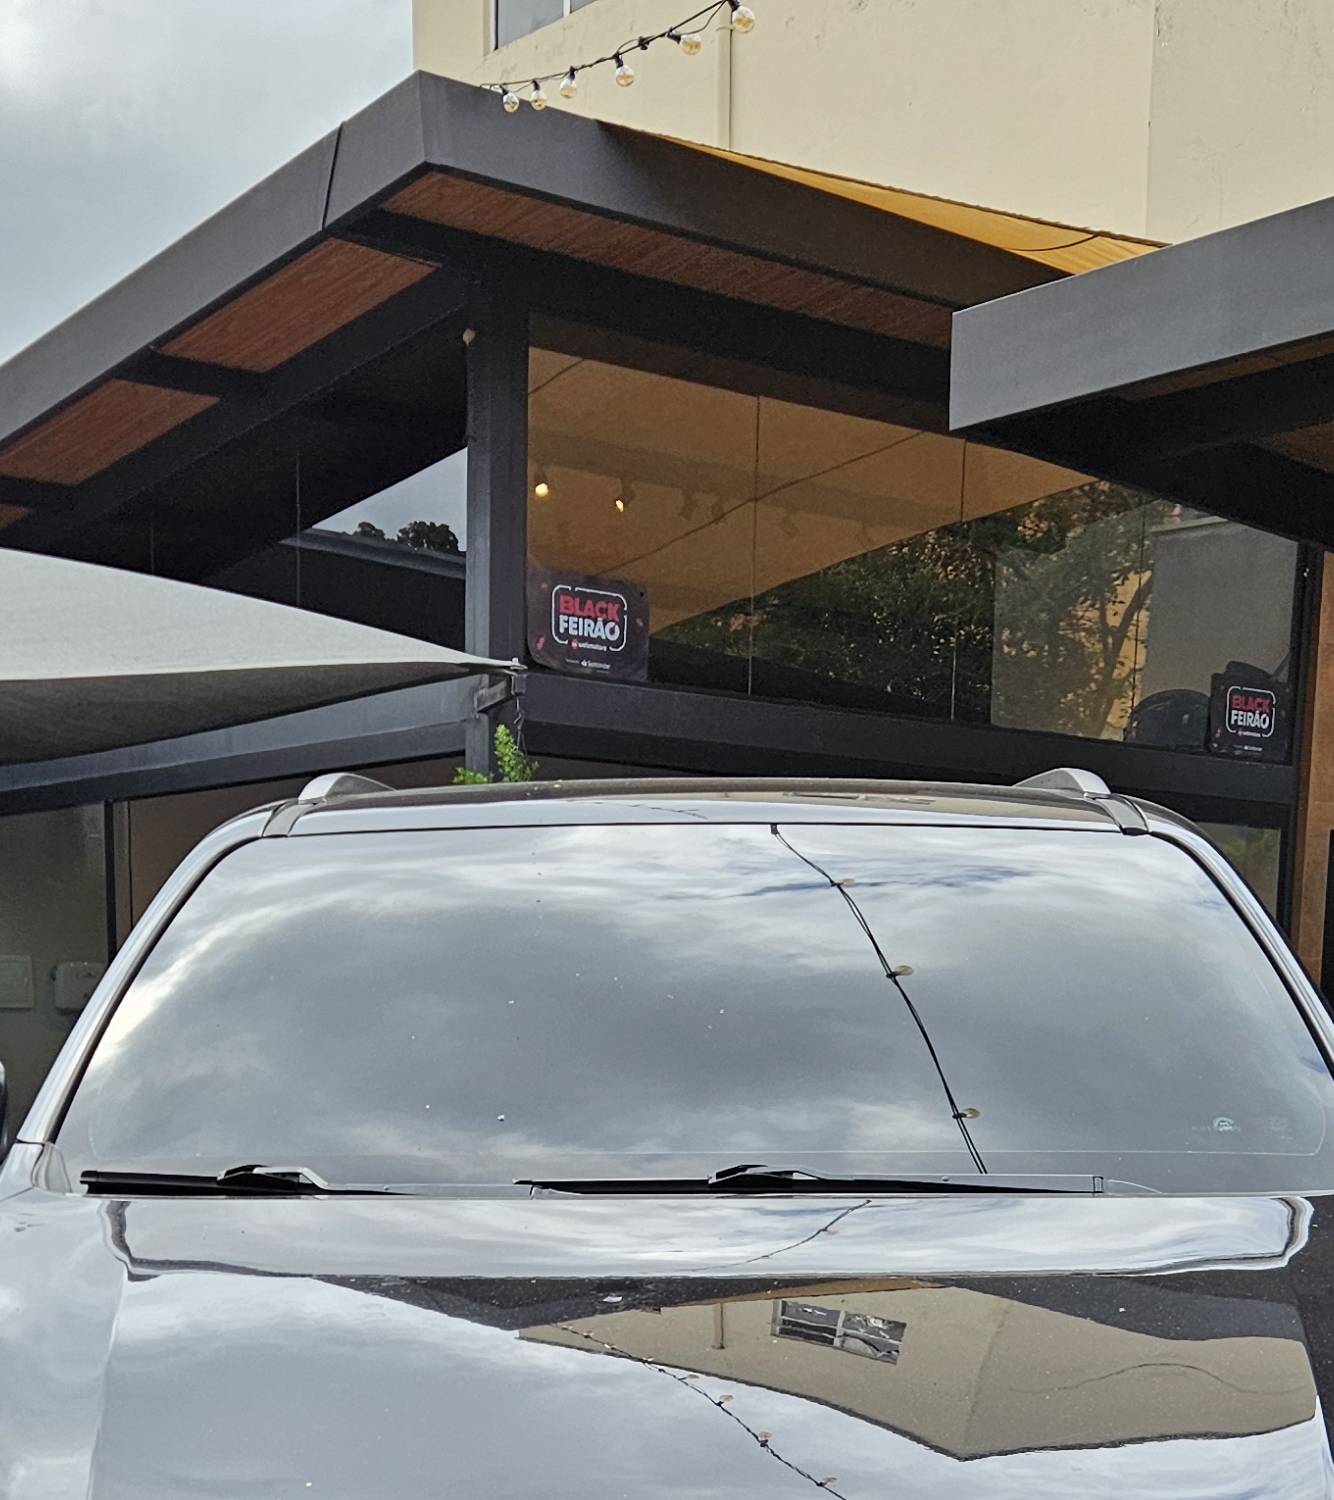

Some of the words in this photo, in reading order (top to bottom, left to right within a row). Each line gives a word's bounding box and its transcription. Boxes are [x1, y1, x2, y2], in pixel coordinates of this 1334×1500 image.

[559, 595, 620, 622] BLACK
[559, 615, 620, 641] FEIRÃO
[1232, 695, 1270, 714] BLACK
[1230, 709, 1270, 729] FEIRÃO
